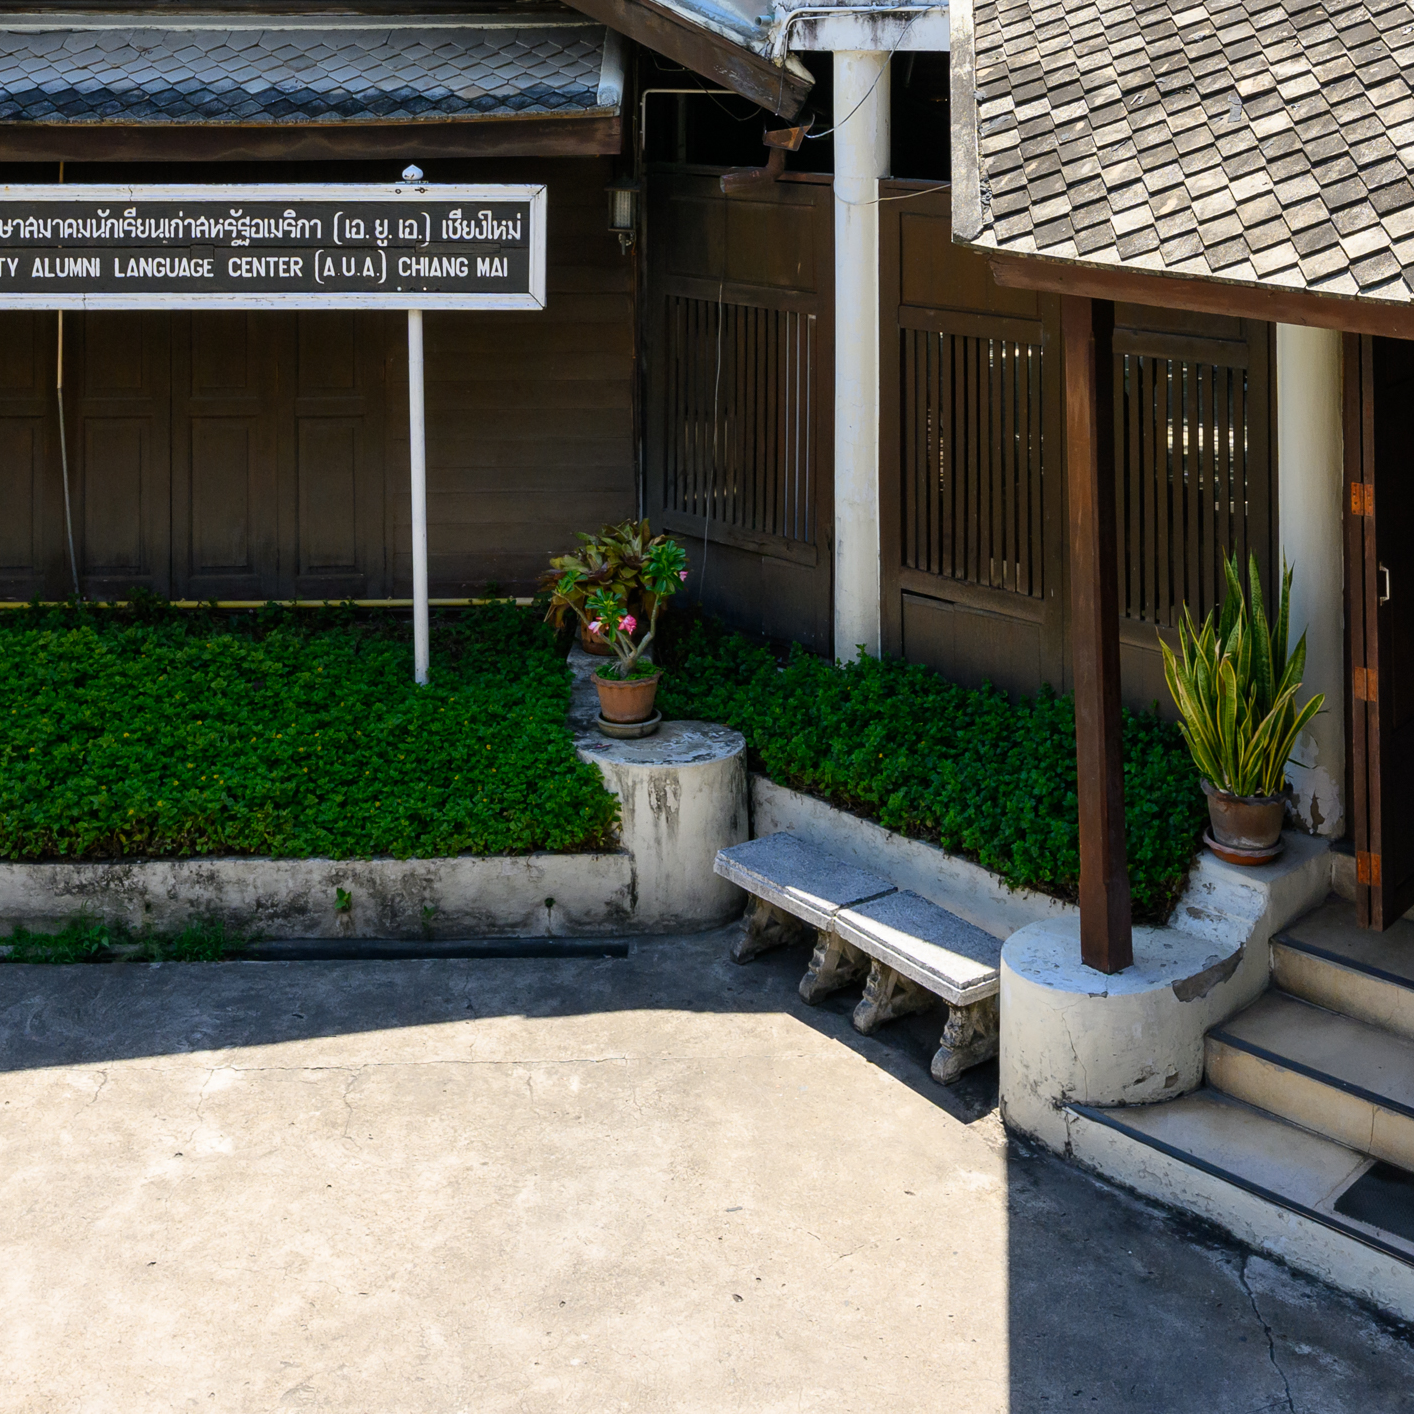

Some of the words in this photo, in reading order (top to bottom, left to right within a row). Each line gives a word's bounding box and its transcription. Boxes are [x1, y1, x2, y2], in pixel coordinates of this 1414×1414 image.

[441, 208, 522, 241] เชียงใหม่
[31, 257, 101, 278] ALUMNI
[114, 257, 215, 278] LANGUAGE
[227, 256, 304, 278] CENTER
[314, 249, 387, 285] (A.U.A.)
[398, 256, 469, 278] CHIANG
[476, 256, 508, 278] MAI
